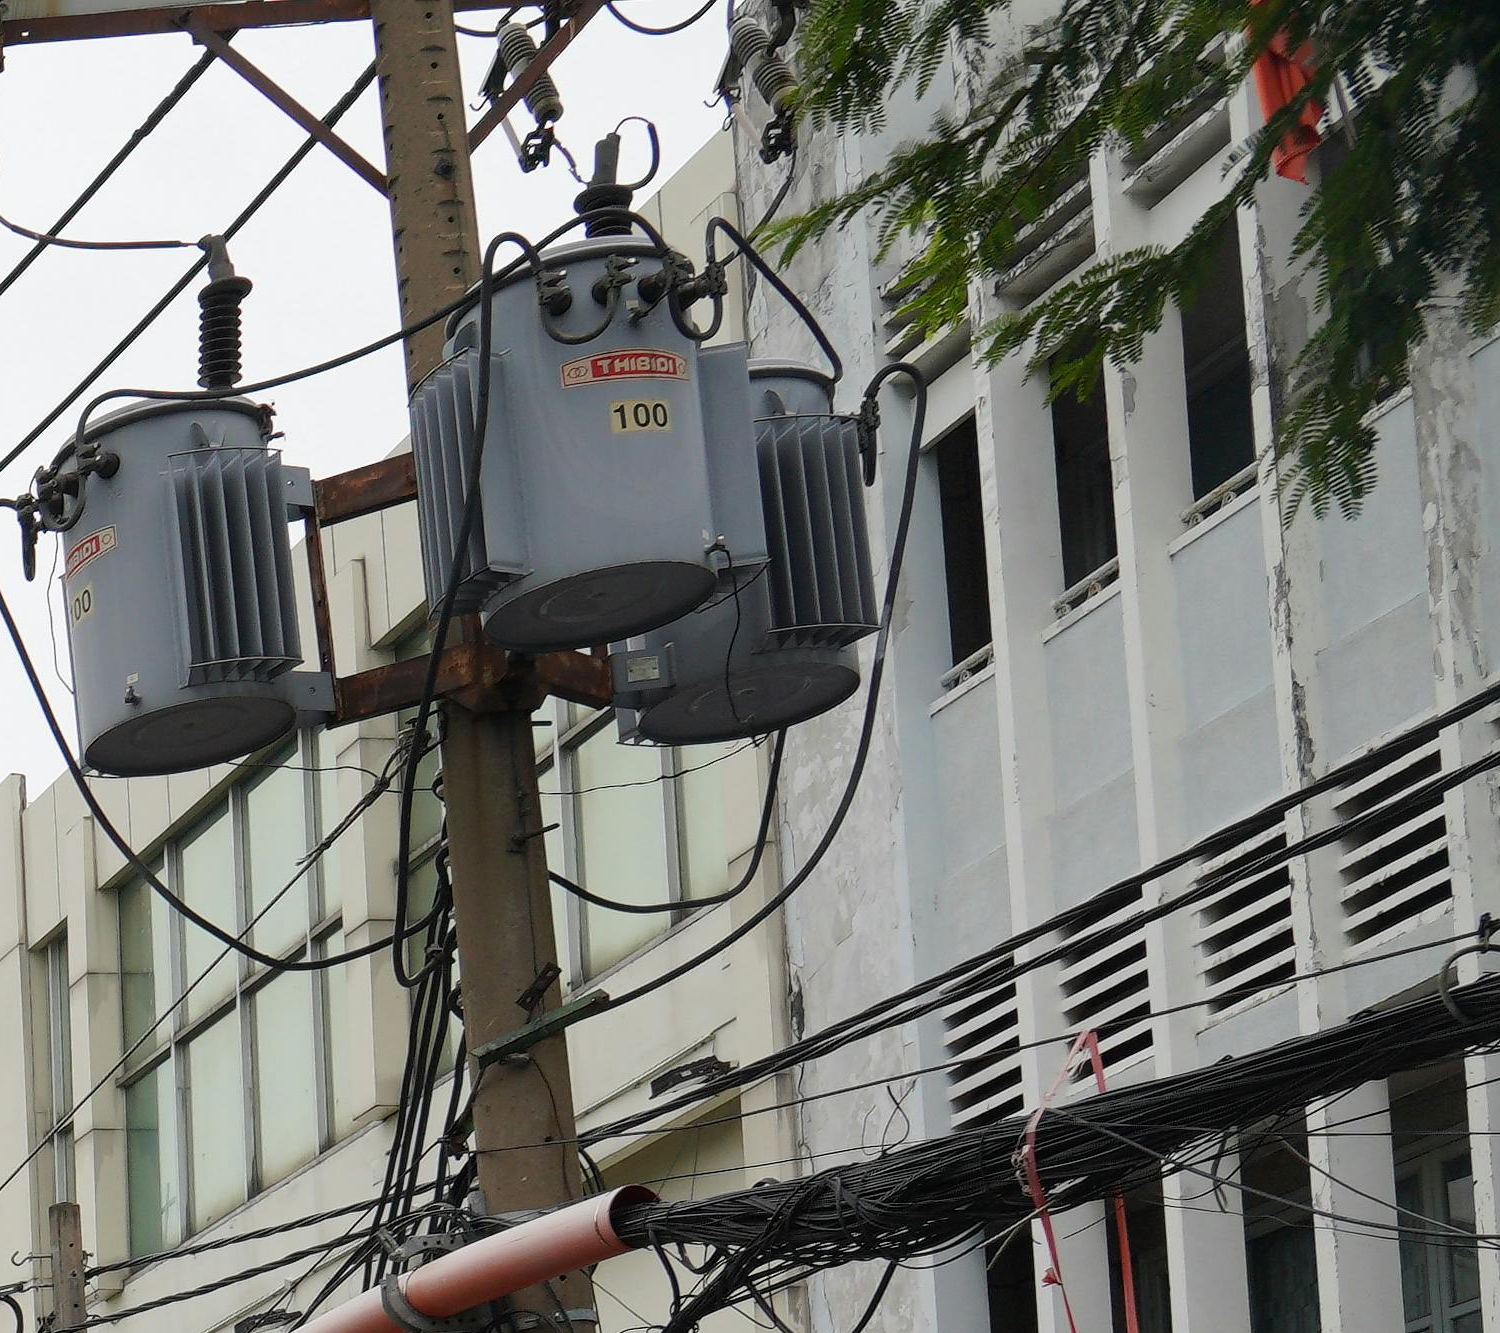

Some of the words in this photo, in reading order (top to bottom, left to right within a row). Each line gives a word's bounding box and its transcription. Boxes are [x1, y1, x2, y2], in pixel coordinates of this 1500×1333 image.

[598, 353, 675, 375] THIBIDI
[612, 401, 669, 432] 100
[71, 589, 91, 621] 00
